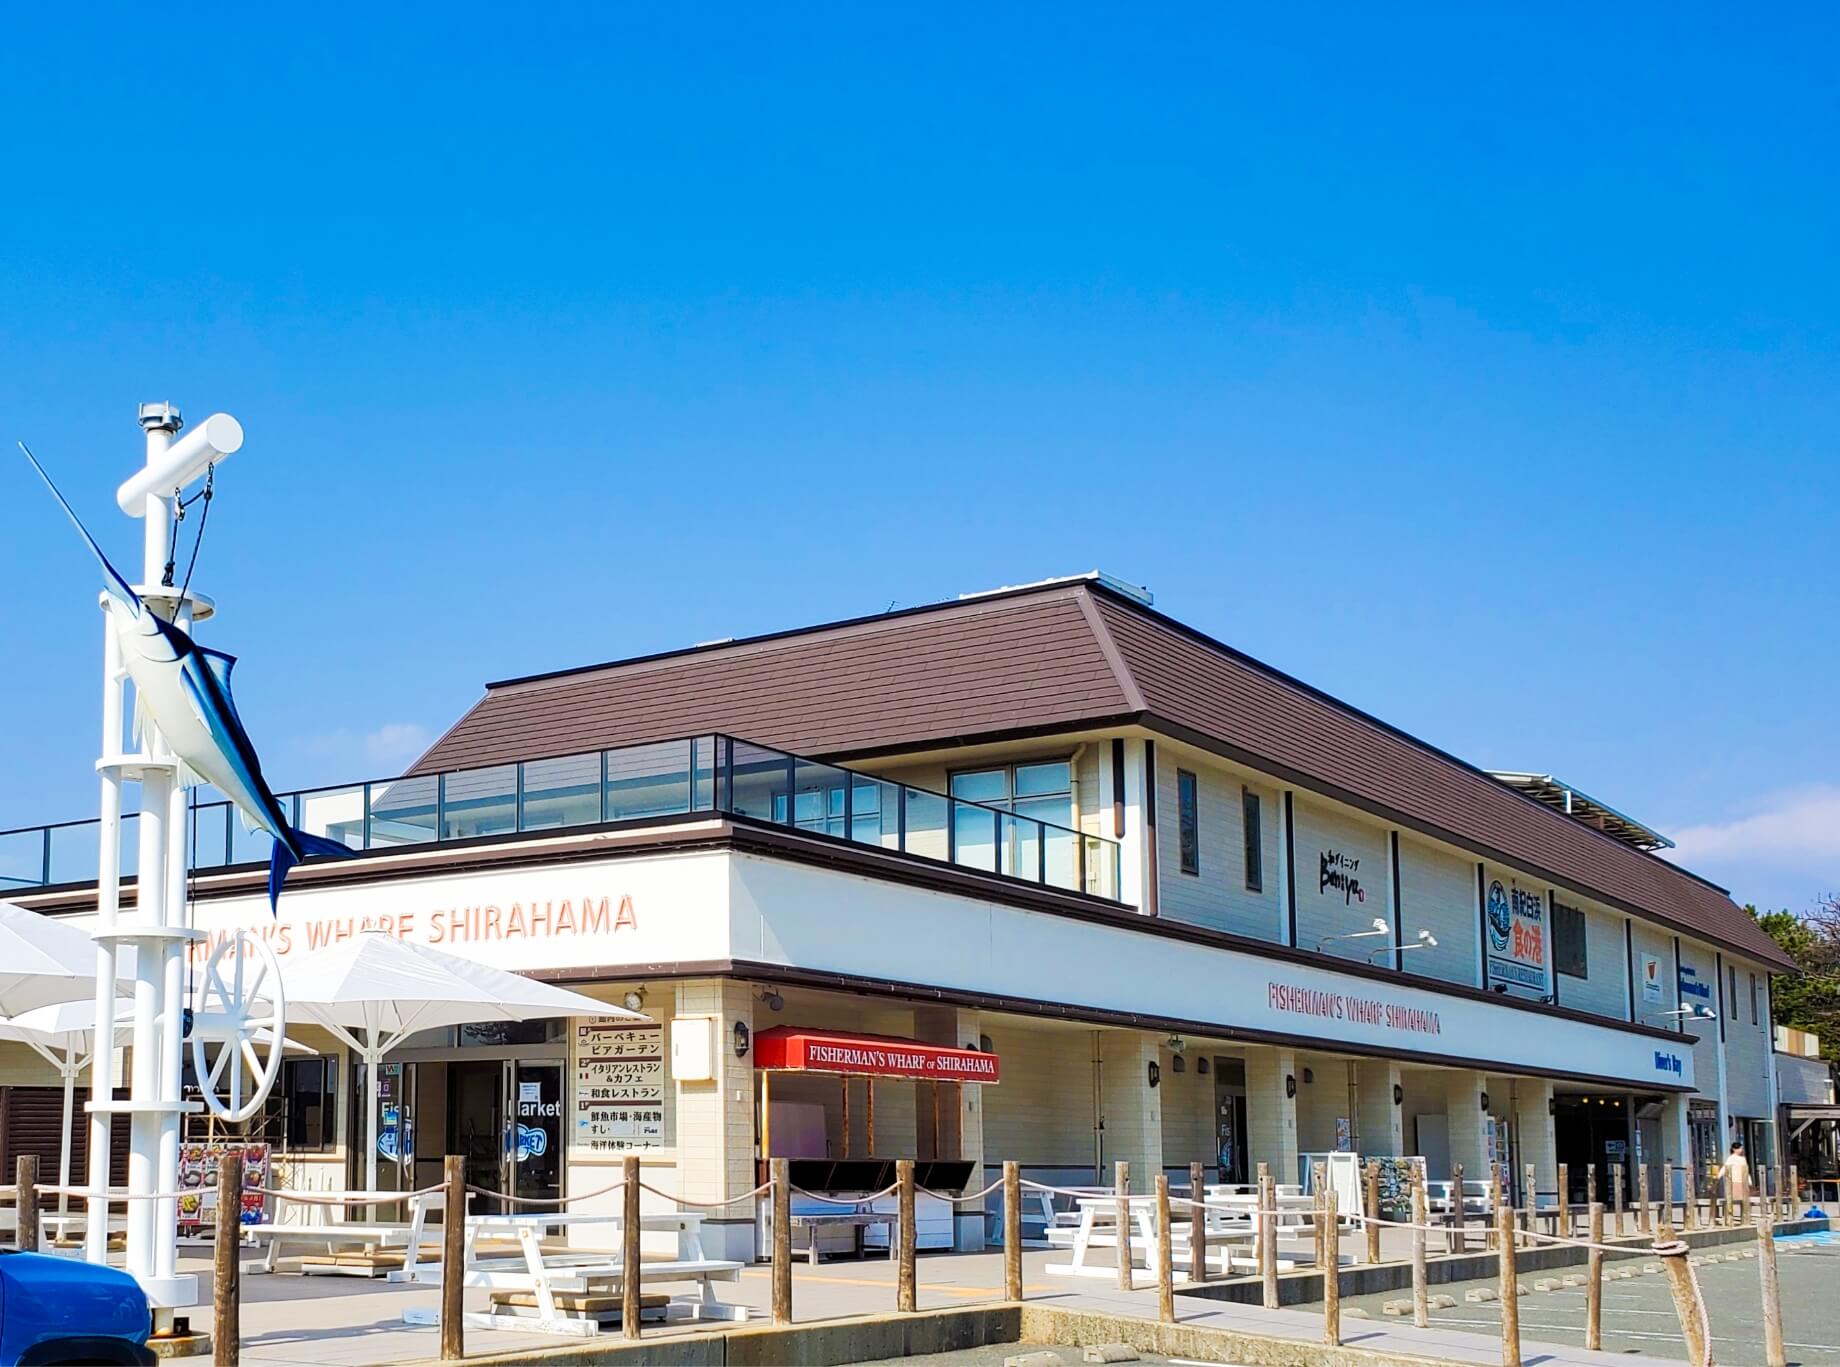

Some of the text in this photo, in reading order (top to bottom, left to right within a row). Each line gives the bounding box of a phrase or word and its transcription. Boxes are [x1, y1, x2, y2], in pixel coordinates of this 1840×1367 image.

[1511, 888, 1542, 921] 南紀白浜
[429, 894, 638, 943] SHIRAHAMA
[1268, 982, 1441, 1035] FISHERMAN'S WHARF SHIRAHAMA
[591, 1032, 660, 1042] バーベキュー
[591, 1044, 660, 1055] ビアガーデン
[809, 1045, 885, 1067] FISHERMAN'S
[887, 1052, 925, 1069] WHARF
[936, 1056, 995, 1074] SHIRAHAMA
[591, 1063, 661, 1074] イタリアンレストラン
[606, 1073, 644, 1083] &カフェ
[591, 1088, 660, 1099] 和食レストラン
[591, 1140, 660, 1150] 海洋体験コーナー
